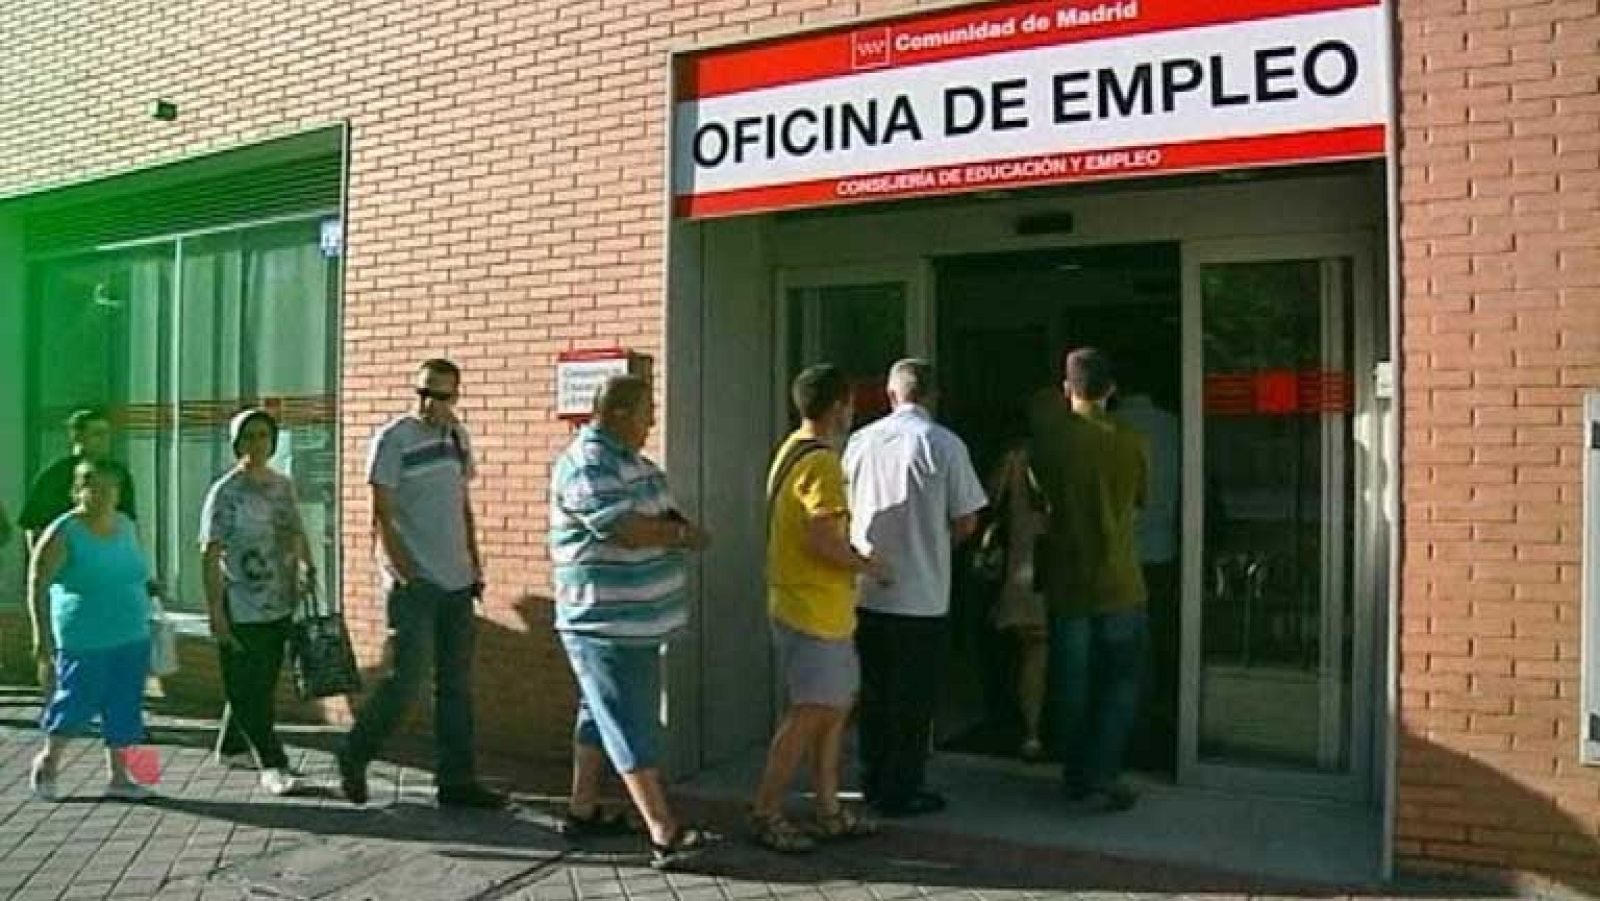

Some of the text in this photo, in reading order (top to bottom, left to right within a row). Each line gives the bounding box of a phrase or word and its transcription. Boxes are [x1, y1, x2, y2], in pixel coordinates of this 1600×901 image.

[895, 2, 1138, 51] Comunidad de Madrid
[693, 39, 1359, 168] OFICINA DE EMPLEO
[939, 167, 962, 184] DE
[1070, 156, 1082, 173] Y
[1085, 149, 1162, 171] EMPLEO
